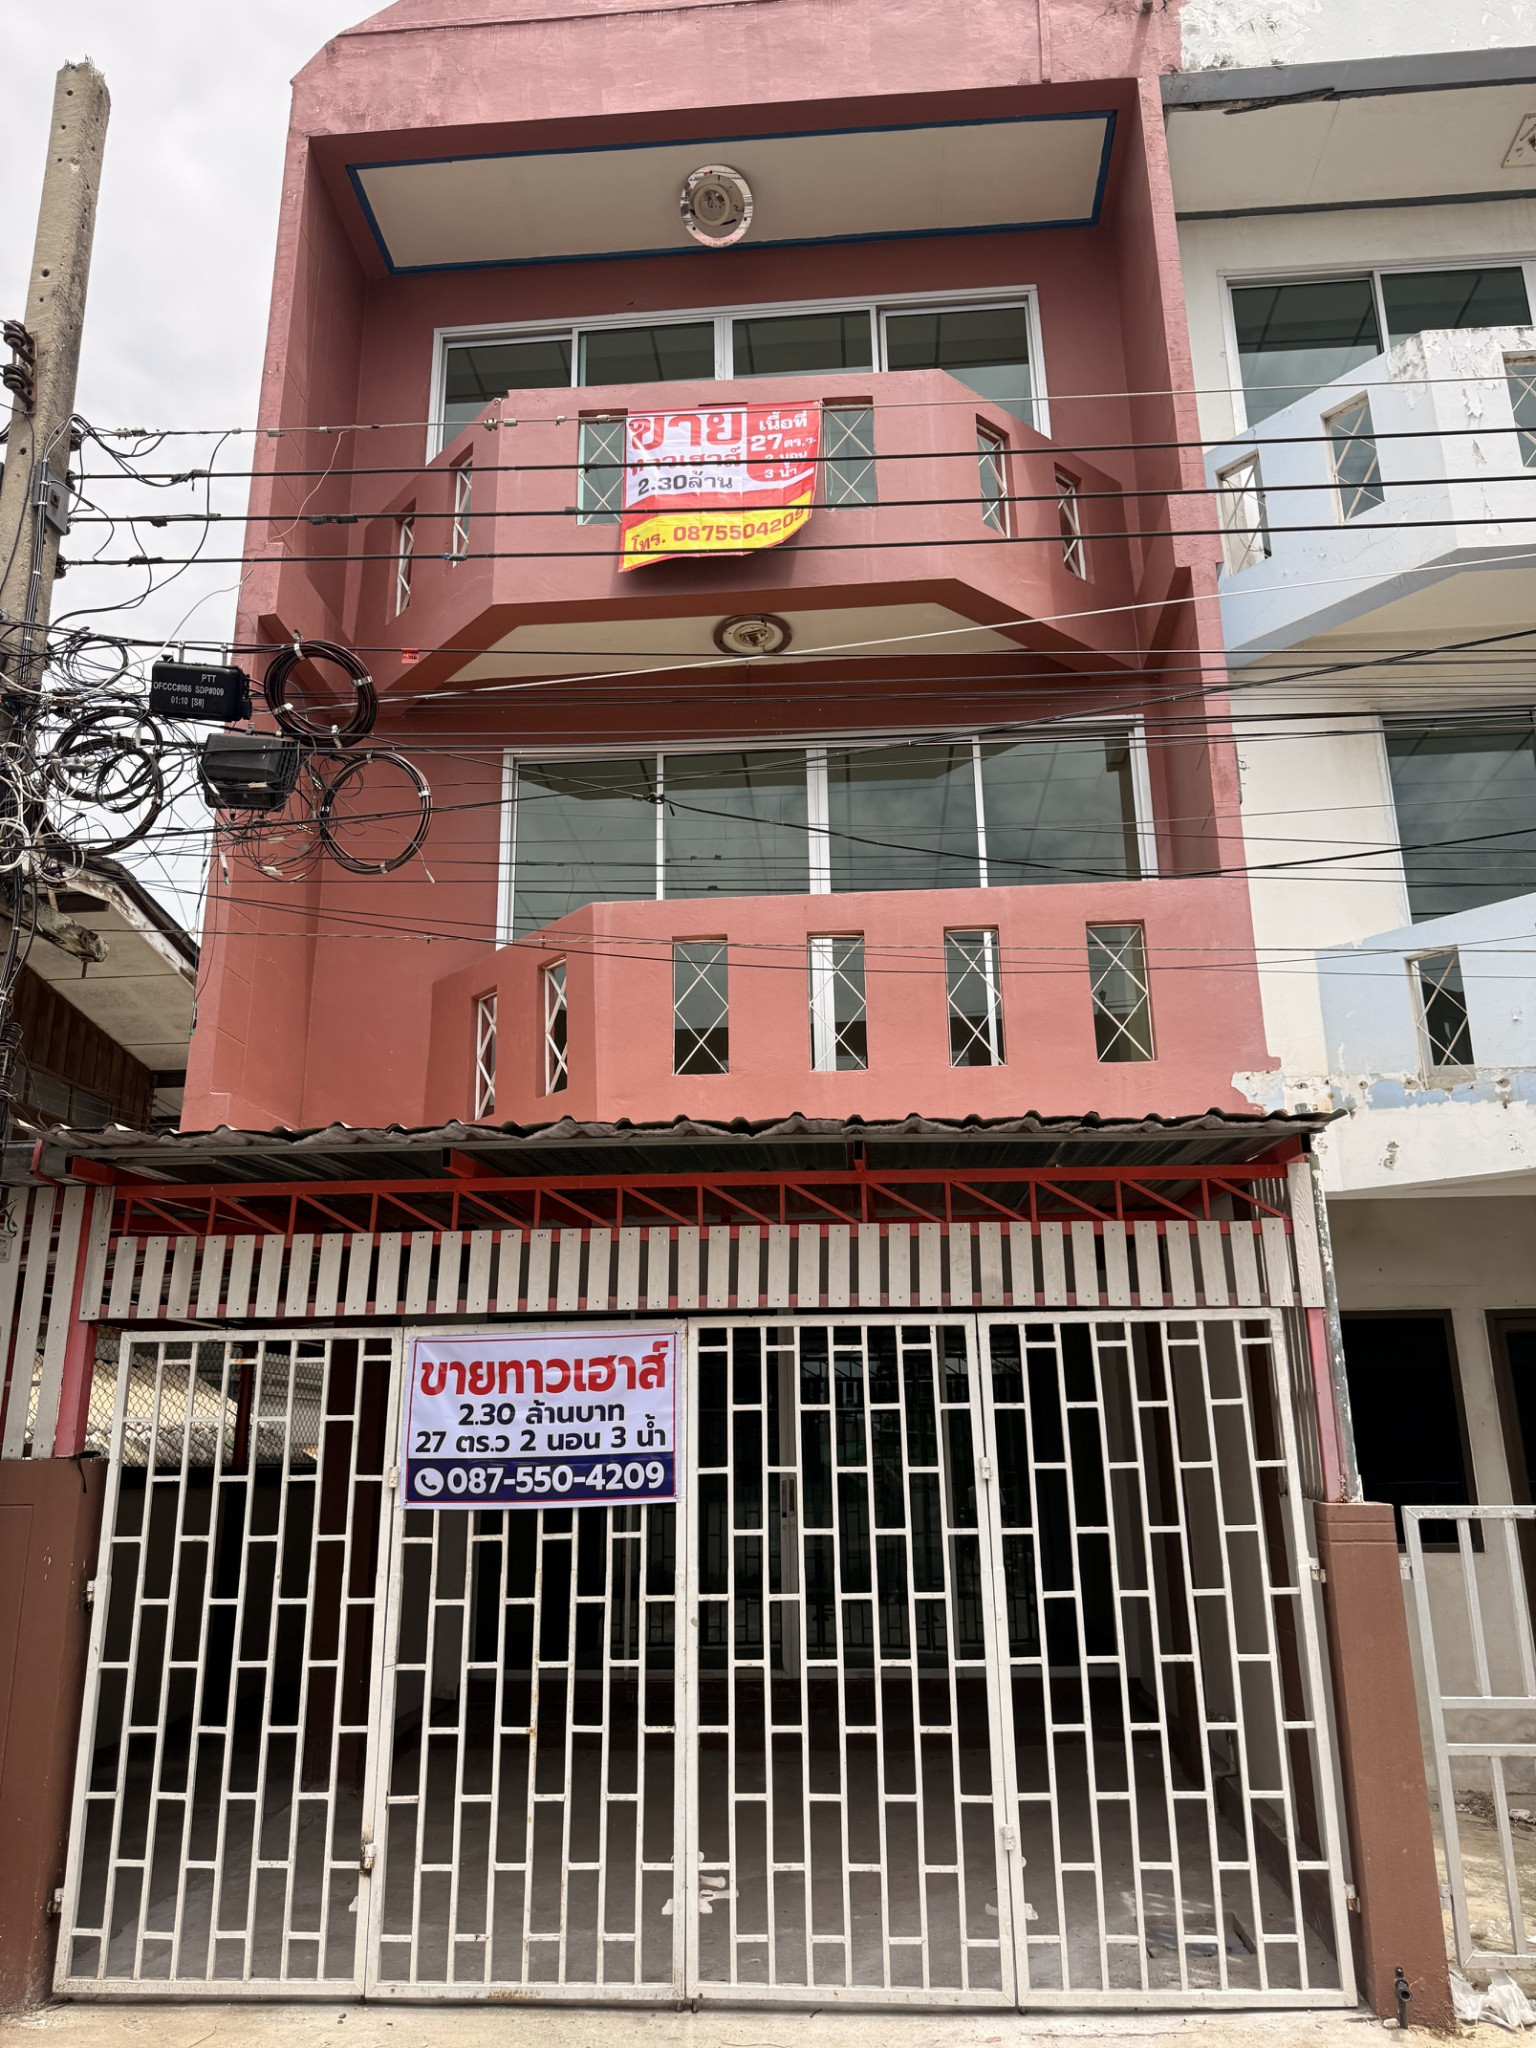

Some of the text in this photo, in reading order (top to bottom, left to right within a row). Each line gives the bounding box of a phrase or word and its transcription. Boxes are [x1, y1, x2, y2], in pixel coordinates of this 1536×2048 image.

[629, 413, 742, 451] ขาย
[759, 410, 807, 431] เนื้อที่
[750, 433, 783, 452] 27
[764, 469, 774, 479] 3
[631, 533, 666, 552] โทร.
[201, 673, 217, 683] PTT
[420, 1341, 669, 1396] ขายทาวเฮาส์
[458, 1399, 625, 1426] 2.30 ล้านบาท
[415, 1414, 666, 1453] 27 ตร.ว 2 นอน 3 น้ำ
[447, 1461, 665, 1494] 087-550-4209
